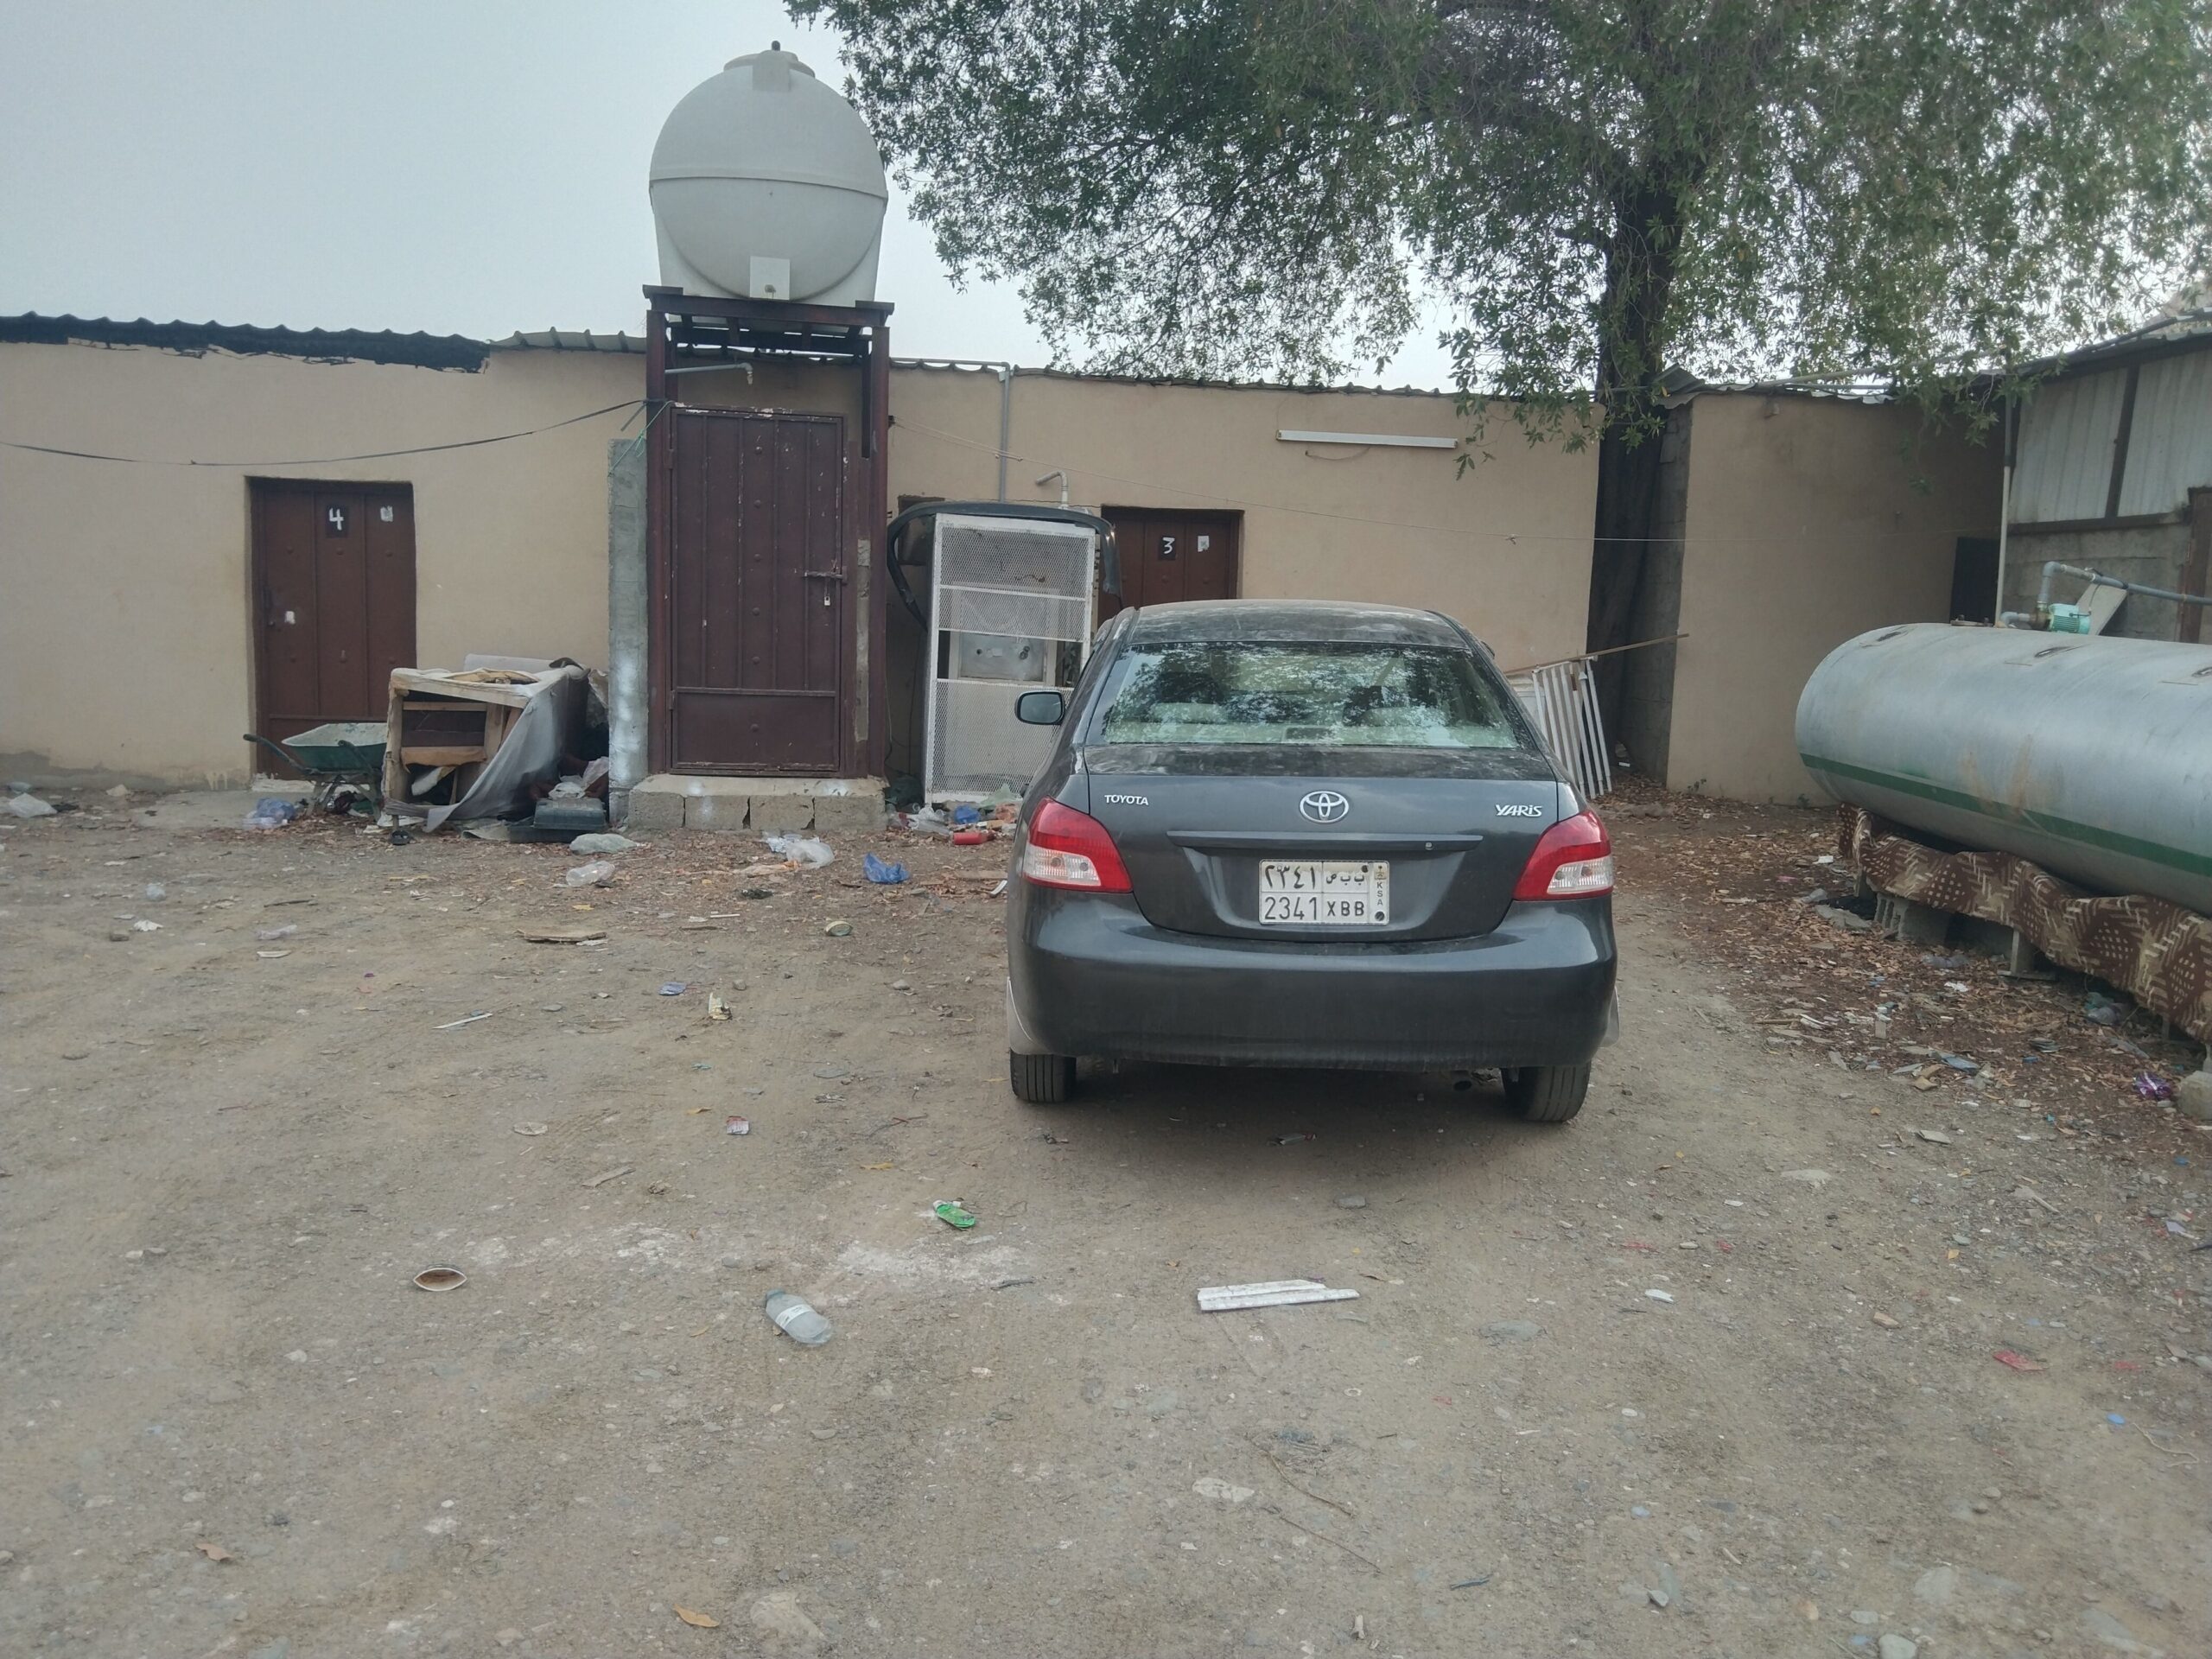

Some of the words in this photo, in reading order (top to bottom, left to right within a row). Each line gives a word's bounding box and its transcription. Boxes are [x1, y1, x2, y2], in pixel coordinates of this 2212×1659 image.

[329, 507, 344, 531] 4
[1162, 537, 1175, 554] 3
[1104, 794, 1149, 805] TOYOTA
[1264, 896, 1318, 920] 2341
[1326, 900, 1365, 917] XBB
